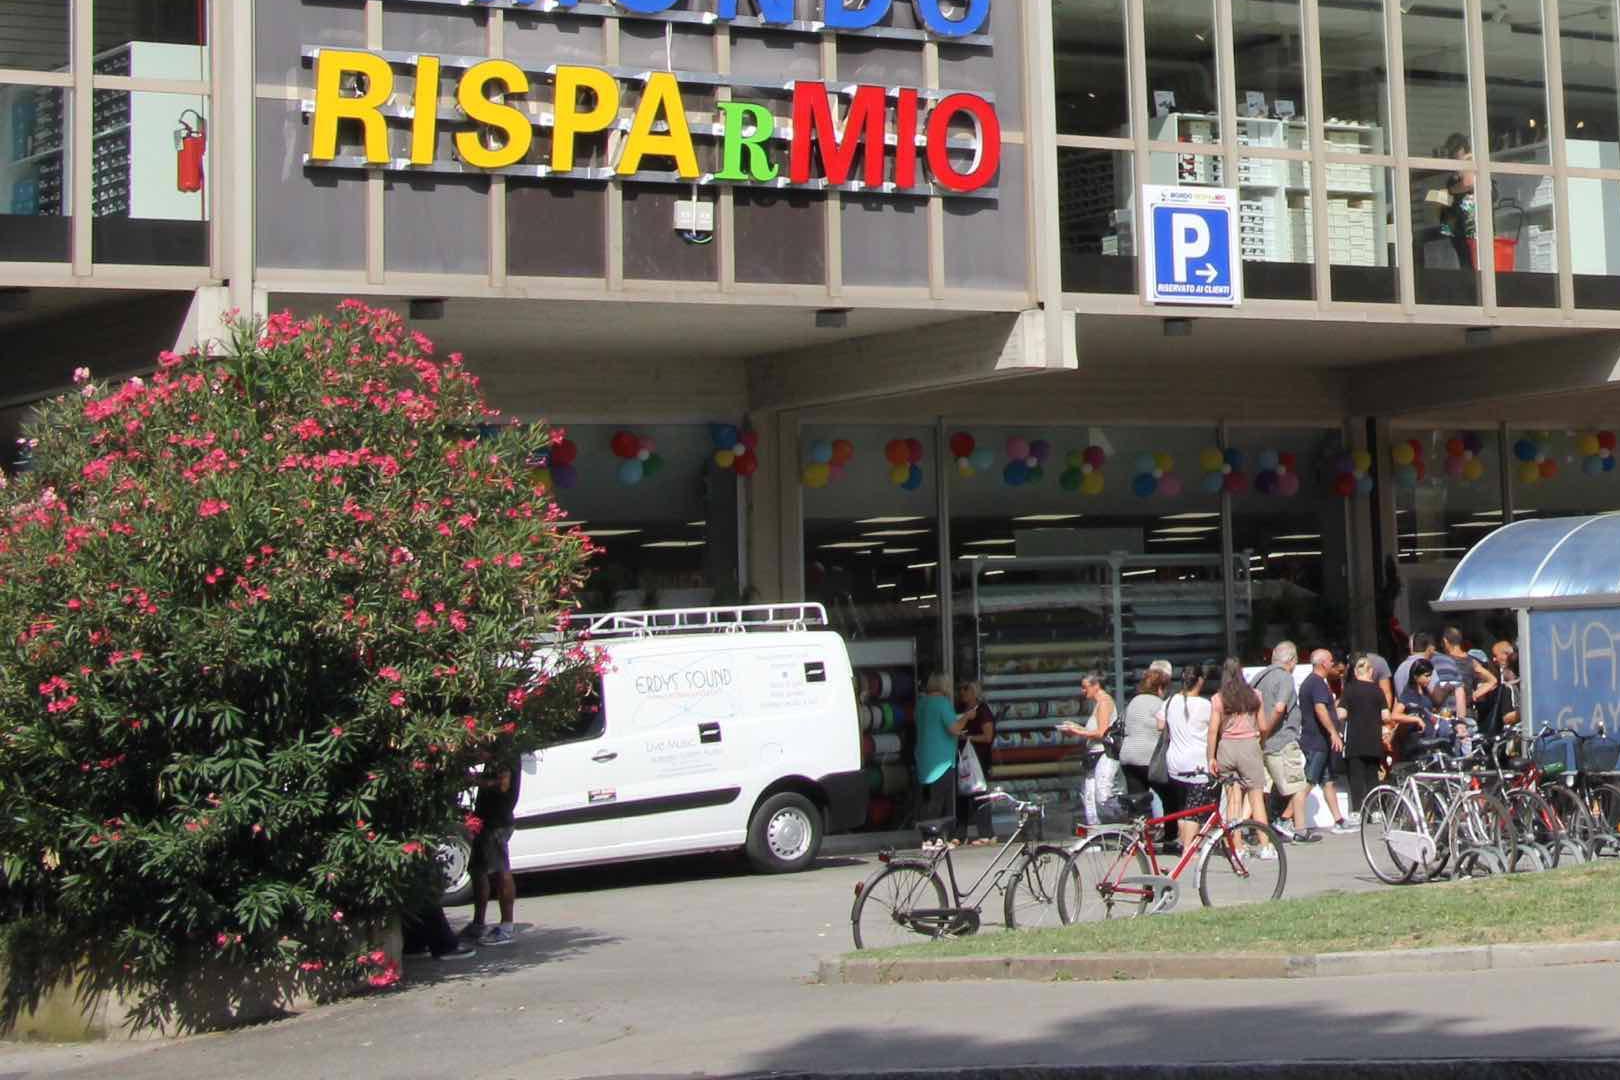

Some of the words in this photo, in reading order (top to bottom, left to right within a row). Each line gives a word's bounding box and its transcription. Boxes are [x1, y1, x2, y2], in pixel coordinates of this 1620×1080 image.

[310, 48, 1001, 193] RISPARMIO
[1172, 212, 1211, 283] P
[1158, 283, 1195, 294] RISERVATO
[1204, 285, 1230, 295] CLIENTI
[685, 668, 733, 689] SOUND
